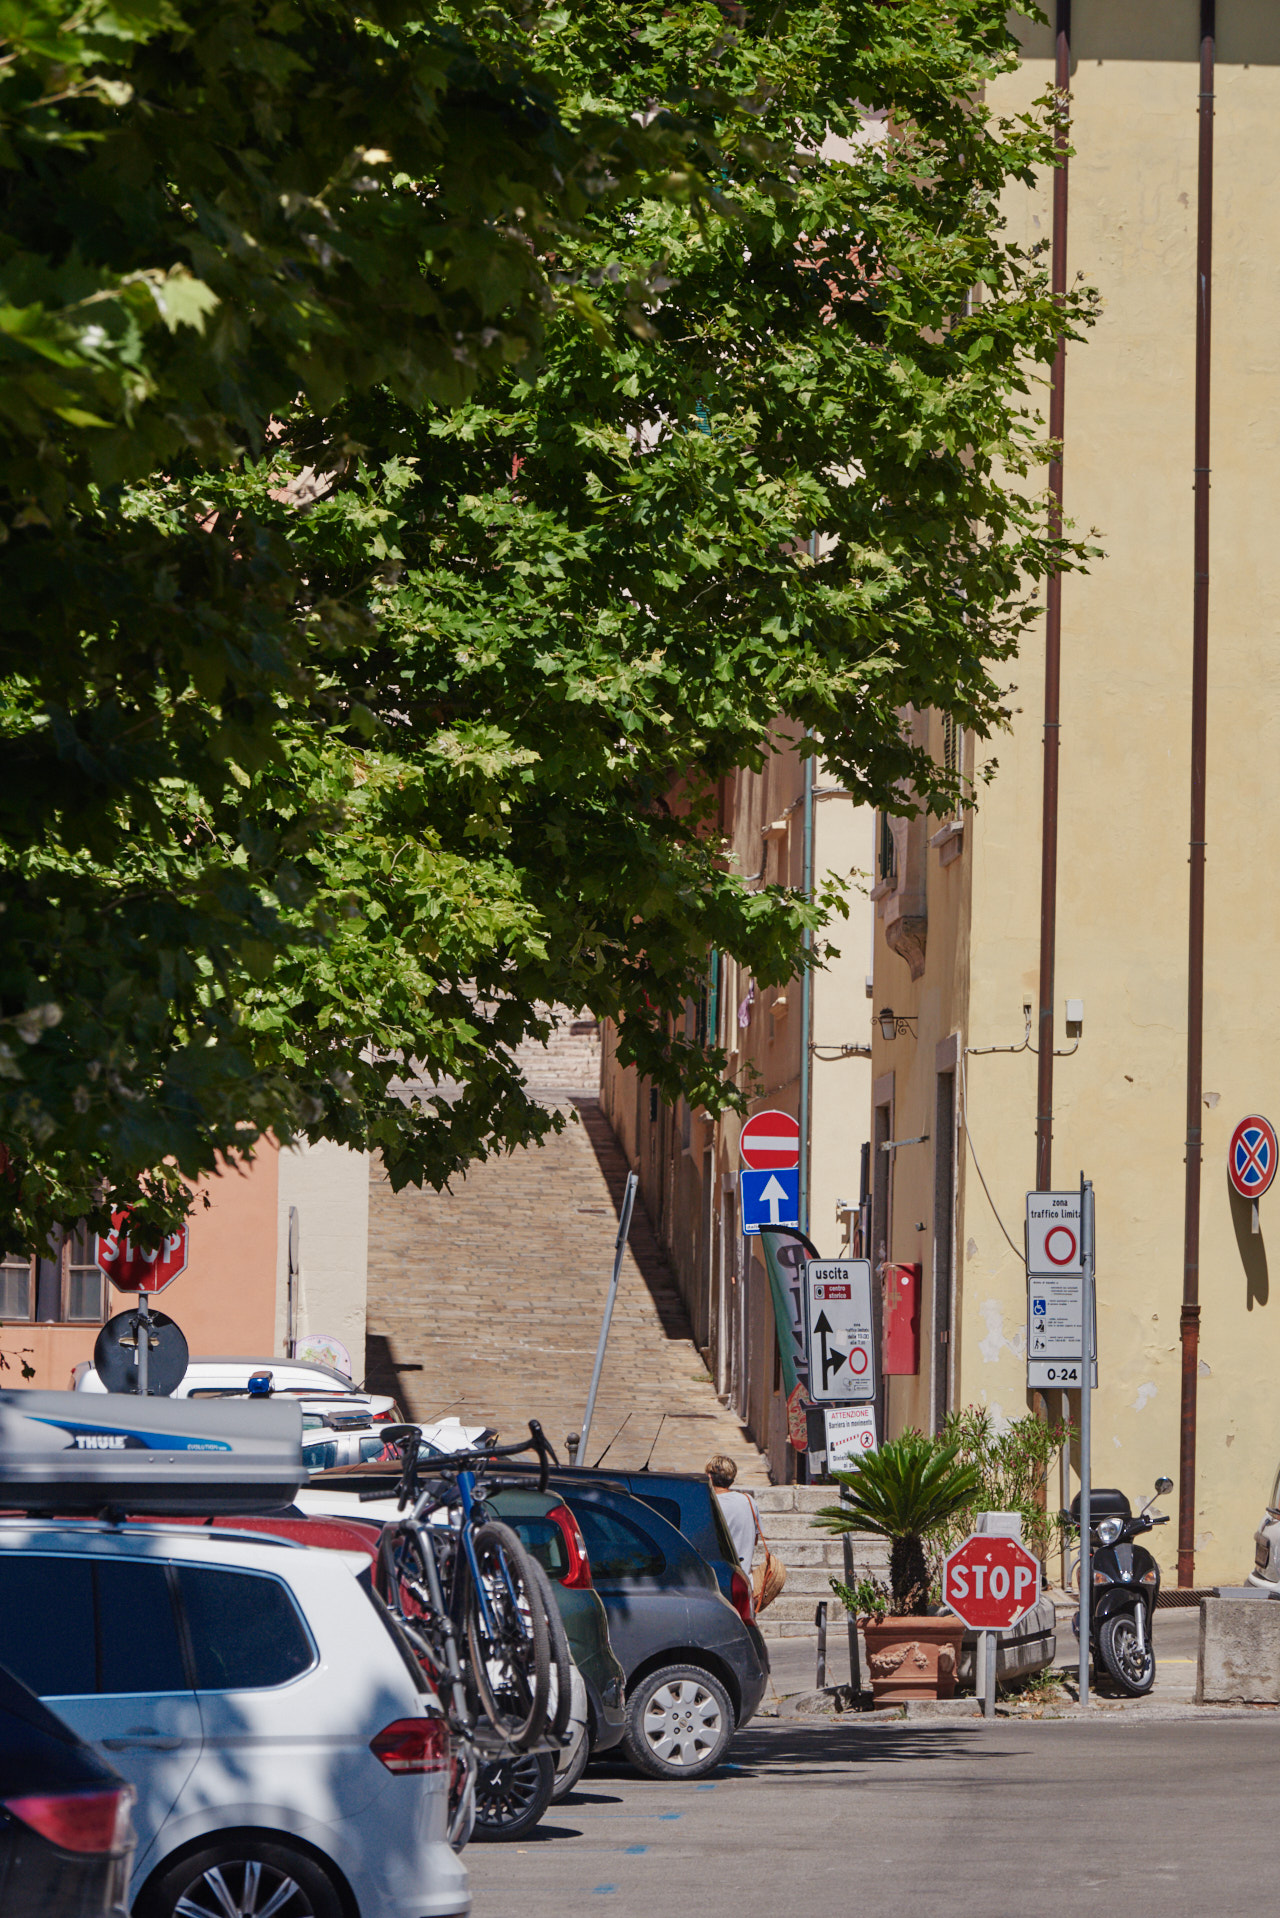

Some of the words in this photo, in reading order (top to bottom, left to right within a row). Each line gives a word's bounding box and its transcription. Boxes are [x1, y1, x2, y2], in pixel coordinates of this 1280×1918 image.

[1031, 1209, 1059, 1219] traffico
[815, 1267, 849, 1280] uscita
[1047, 1368, 1078, 1381] 0-24
[831, 1410, 869, 1419] ATTENZIONE
[75, 1435, 128, 1449] THULE
[950, 1564, 1033, 1600] STOP
